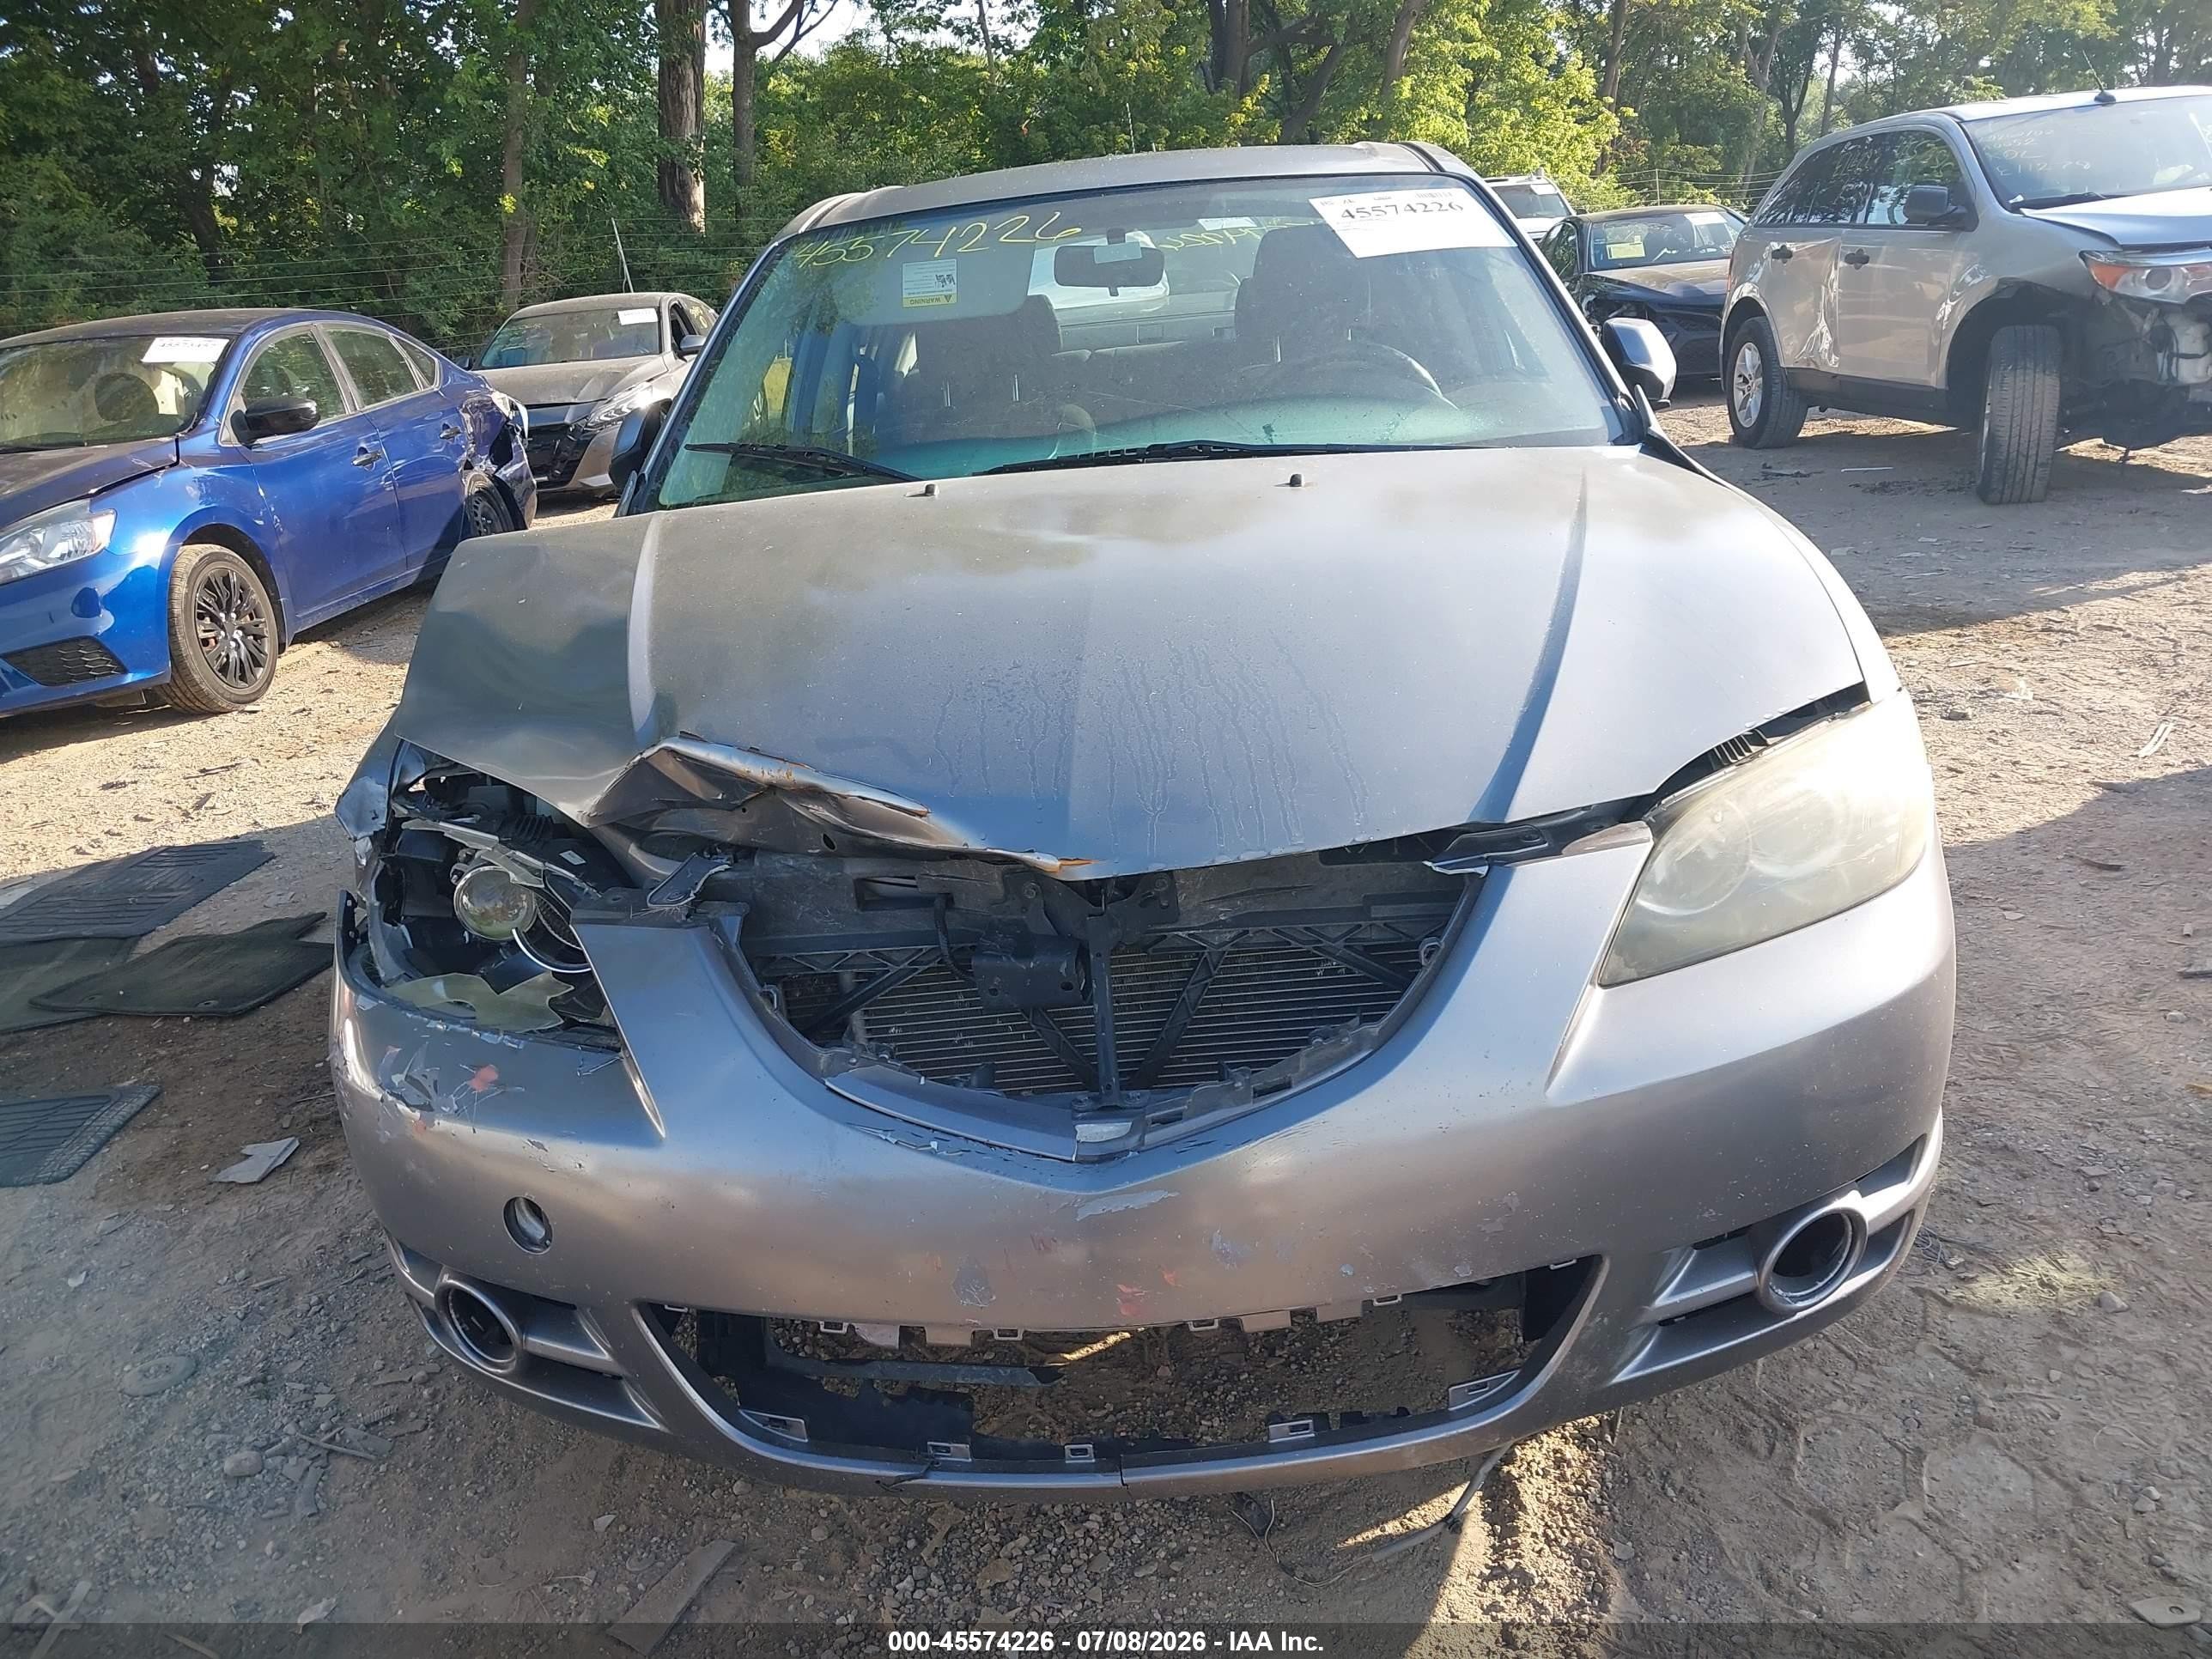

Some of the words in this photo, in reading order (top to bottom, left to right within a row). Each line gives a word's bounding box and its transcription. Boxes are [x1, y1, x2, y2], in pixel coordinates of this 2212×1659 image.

[1341, 201, 1464, 220] 45574226
[793, 211, 1082, 268] 45574226
[909, 296, 941, 305] WARNING
